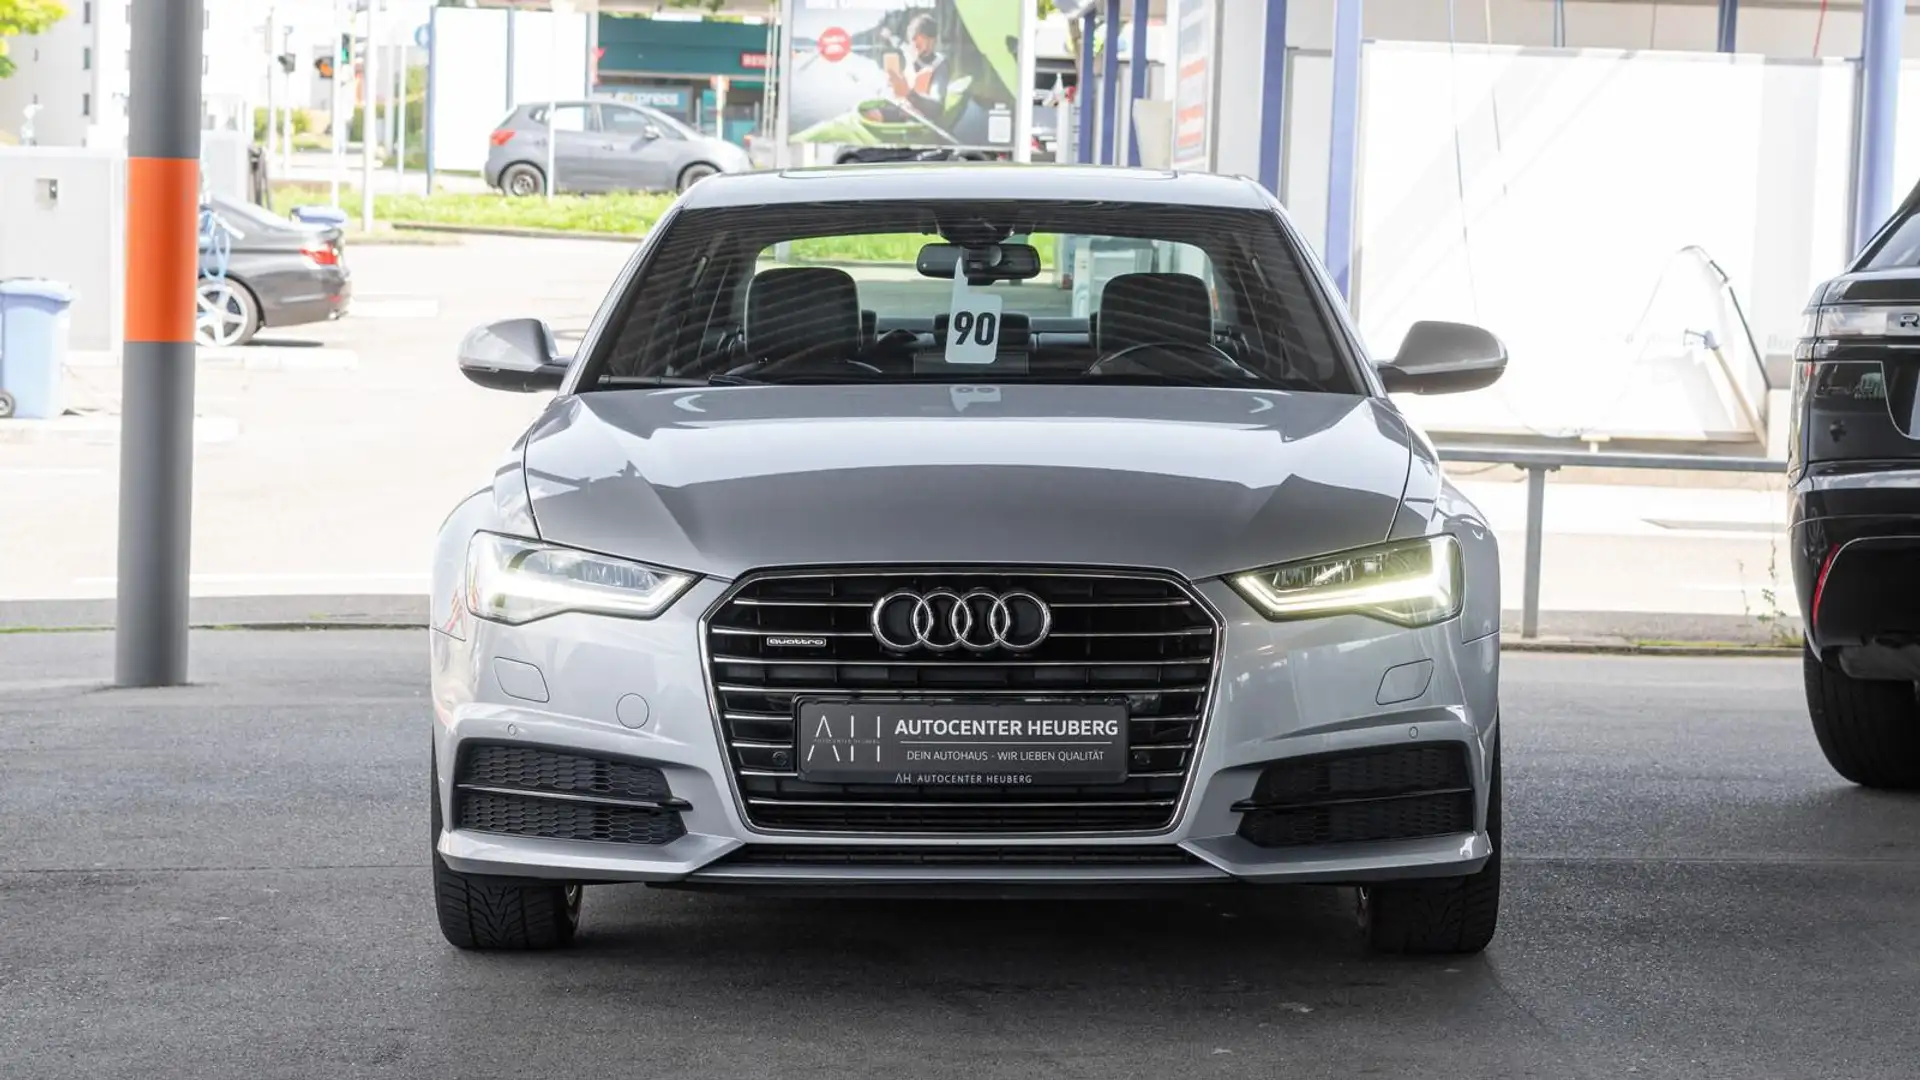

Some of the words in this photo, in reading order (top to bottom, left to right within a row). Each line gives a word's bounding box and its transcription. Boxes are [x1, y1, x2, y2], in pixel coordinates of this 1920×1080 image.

[954, 310, 997, 346] 90
[894, 719, 1022, 735] AUTOCENTER
[1027, 719, 1119, 736] HEUBERG
[907, 751, 931, 760] DEIN
[933, 751, 988, 761] AUTOHAUS
[997, 752, 1018, 761] WIR
[1020, 751, 1056, 761] LIEBEN
[1058, 750, 1104, 762] QUALITÄT
[917, 774, 983, 784] AUTOCENTER
[986, 774, 1032, 784] HEUBERG
